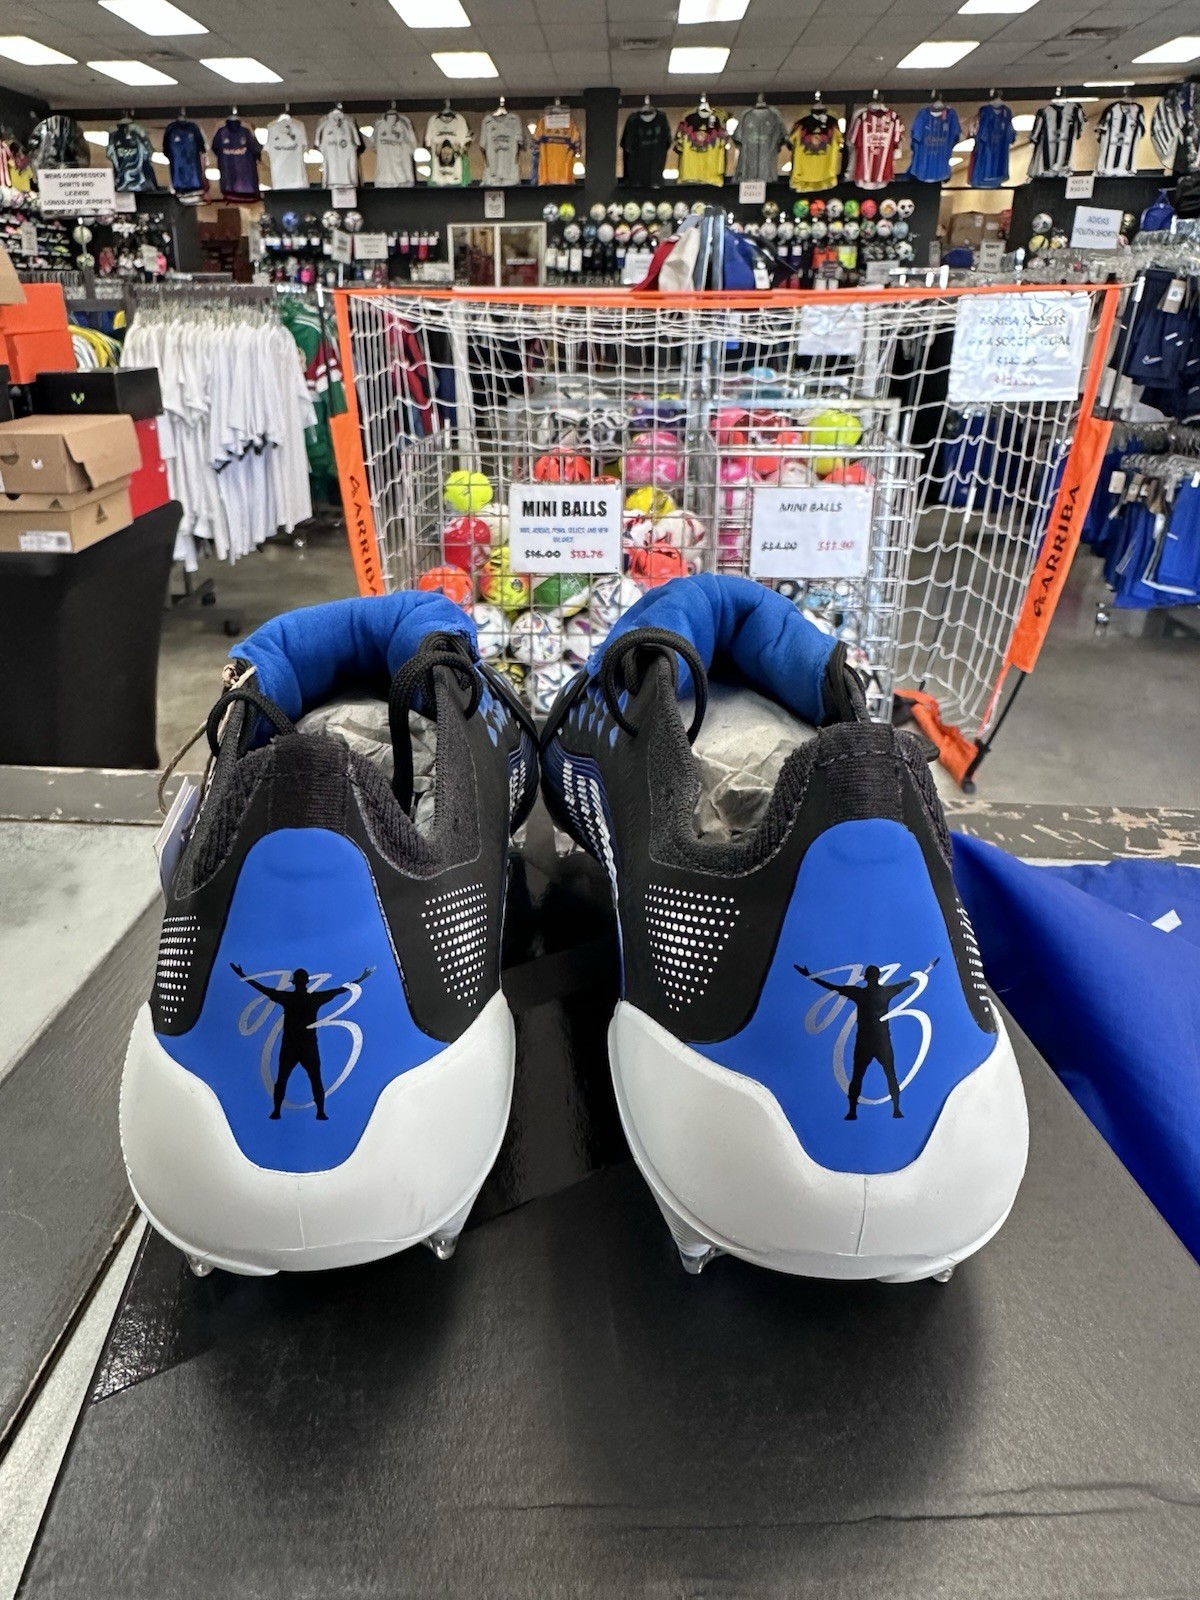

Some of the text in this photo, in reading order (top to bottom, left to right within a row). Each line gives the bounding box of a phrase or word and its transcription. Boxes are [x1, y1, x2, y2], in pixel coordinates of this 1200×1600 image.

[522, 500, 607, 517] MINI BALLS
[779, 502, 843, 512] MINI BALLS
[1041, 484, 1080, 592] ARRIBA
